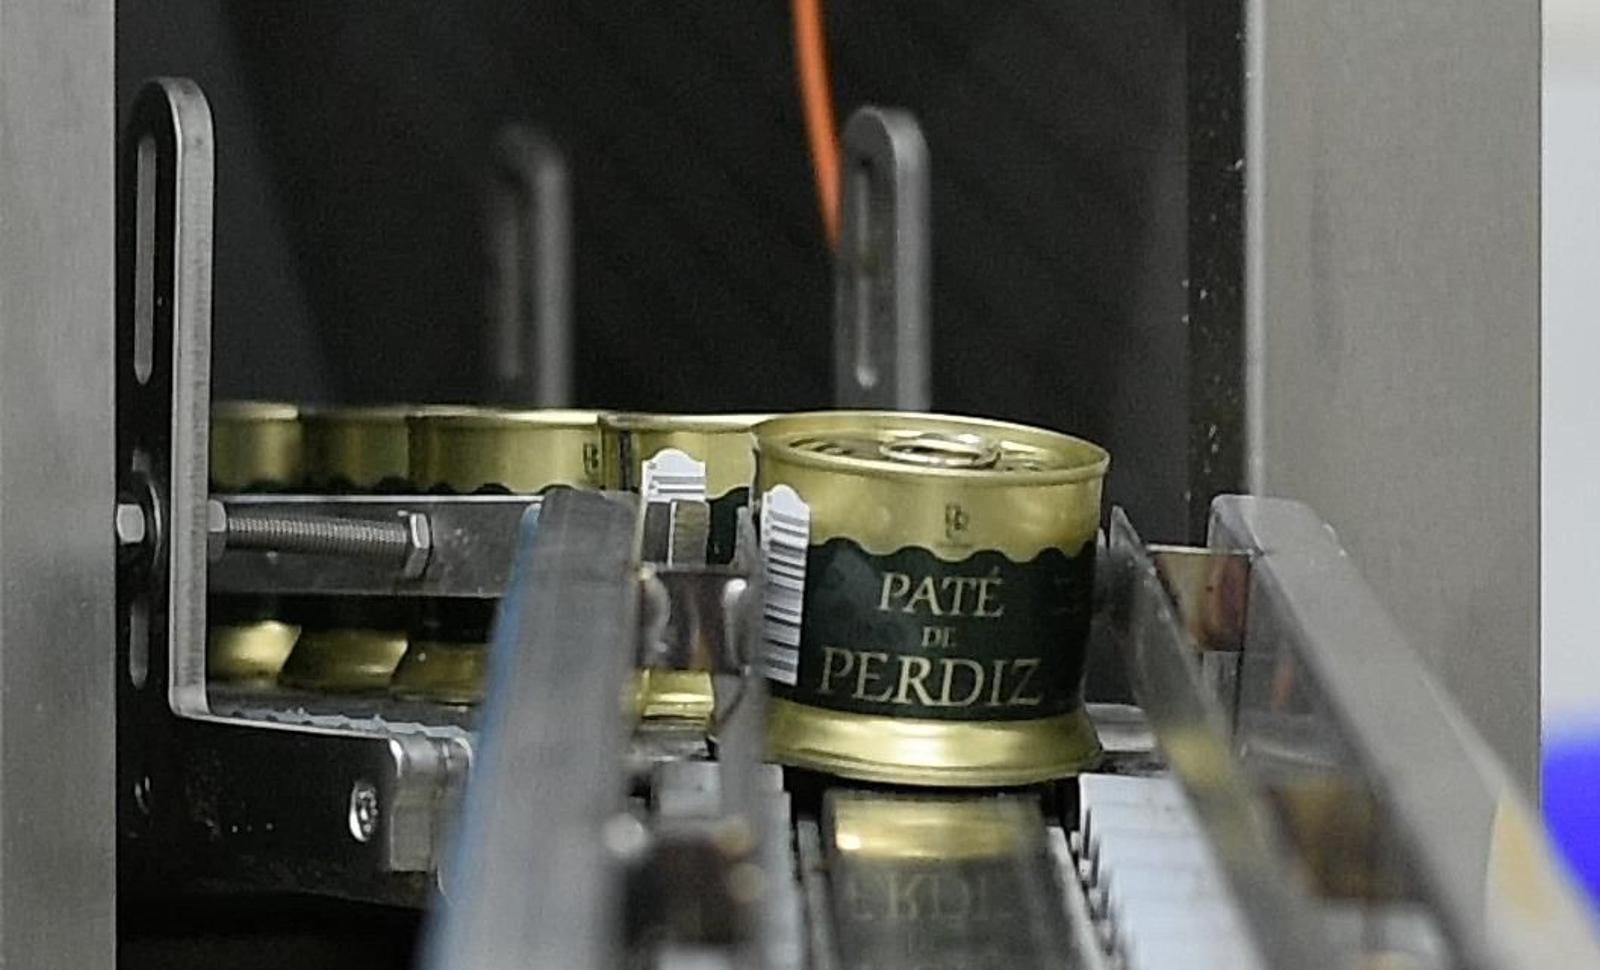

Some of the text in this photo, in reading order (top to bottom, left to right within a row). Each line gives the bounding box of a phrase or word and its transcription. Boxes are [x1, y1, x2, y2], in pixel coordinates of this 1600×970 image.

[878, 566, 1005, 618] PATÉ
[920, 625, 958, 649] DE
[816, 646, 1045, 708] PERDIZ
